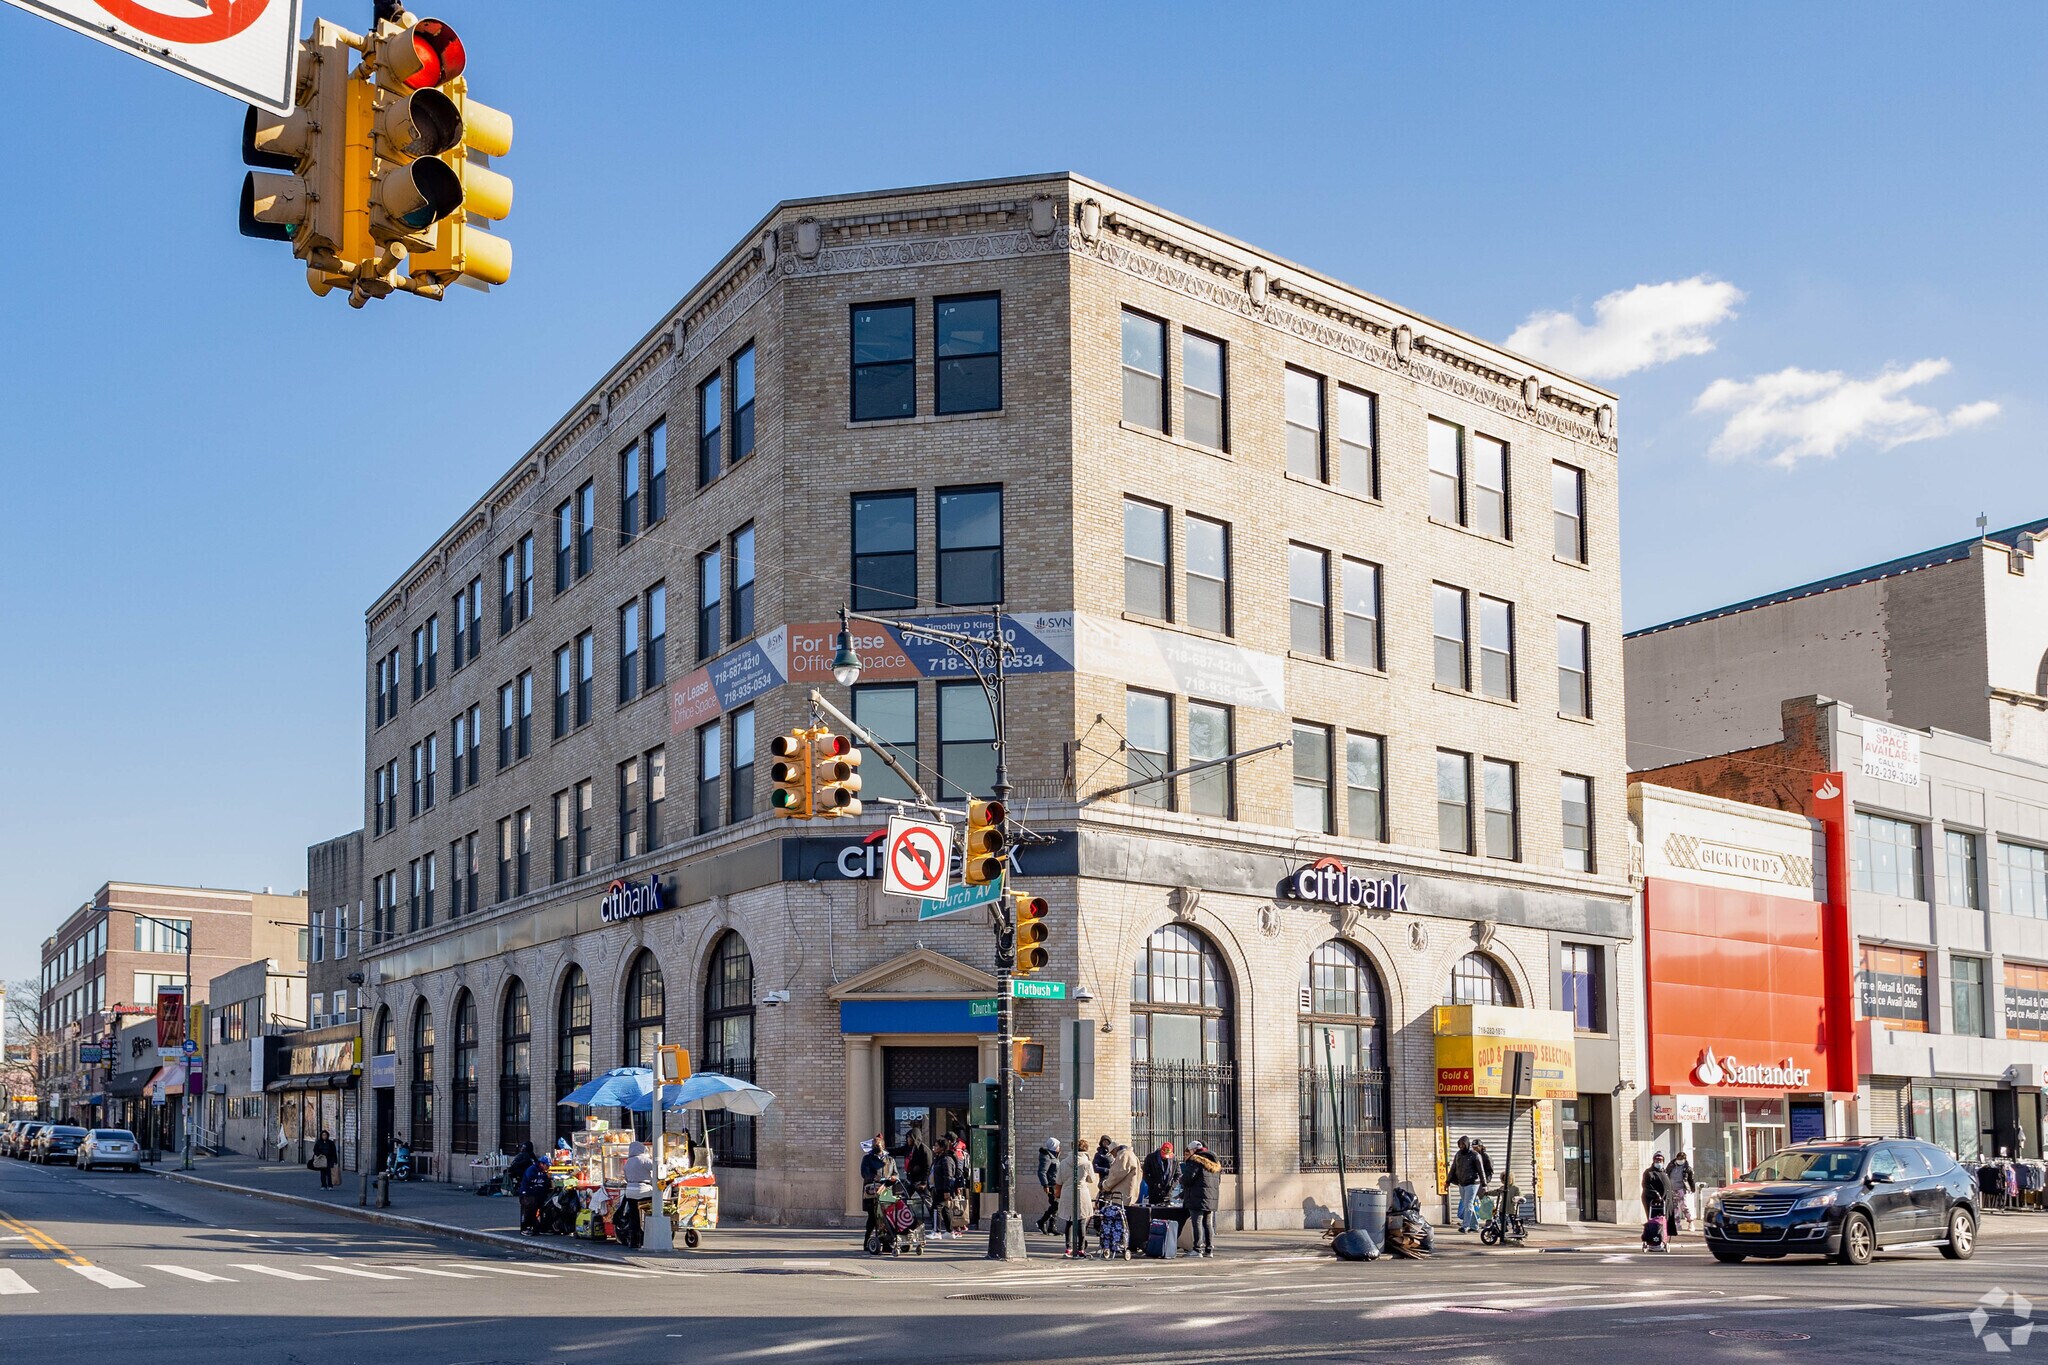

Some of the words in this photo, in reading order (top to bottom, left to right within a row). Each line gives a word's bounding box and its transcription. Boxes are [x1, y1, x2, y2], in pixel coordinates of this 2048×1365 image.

[131, 35, 188, 63] TRANSPOATION
[973, 621, 994, 630] King
[1048, 617, 1072, 628] SVN
[793, 635, 823, 652] For
[829, 633, 885, 651] Lase
[715, 653, 760, 686] 718-687-4210
[793, 655, 834, 672] Offic
[928, 654, 1044, 671] 718-930534
[1166, 648, 1244, 675] 718-687-4210
[674, 691, 686, 708] For
[687, 680, 709, 701] Lease
[724, 672, 772, 705] 718-935-0534
[674, 706, 694, 725] Office
[695, 695, 717, 716] Space
[1877, 734, 1909, 751] SPACE
[1865, 743, 1919, 764] AVAILABLE
[1878, 758, 1895, 768] CALL
[837, 838, 1023, 877] citk
[1702, 849, 1779, 874] BICKFORD'S
[1298, 865, 1410, 912] citibank
[600, 874, 659, 923] citibank
[932, 888, 971, 912] Church
[1017, 983, 1051, 996] Flatbush
[1859, 979, 1874, 991] rime
[1877, 981, 1896, 993] Retail
[1896, 983, 1902, 994] &
[1904, 984, 1923, 996] Office
[114, 1005, 140, 1013] PAWN
[971, 1002, 991, 1015] Church
[1863, 993, 1886, 1007] Space
[1887, 995, 1918, 1009] Available
[2005, 994, 2015, 1005] ime
[2017, 995, 2033, 1007] Retail
[2033, 997, 2039, 1007] &
[2006, 1007, 2025, 1020] Space
[1478, 1047, 1495, 1068] GOLD
[1496, 1045, 1502, 1062] &
[1541, 1045, 1572, 1068] SELECTION
[1442, 1070, 1461, 1080] Gold
[1463, 1071, 1469, 1079] &
[1726, 1055, 1811, 1086] Santander
[1438, 1082, 1474, 1092] Diamond
[901, 1110, 924, 1121] 885
